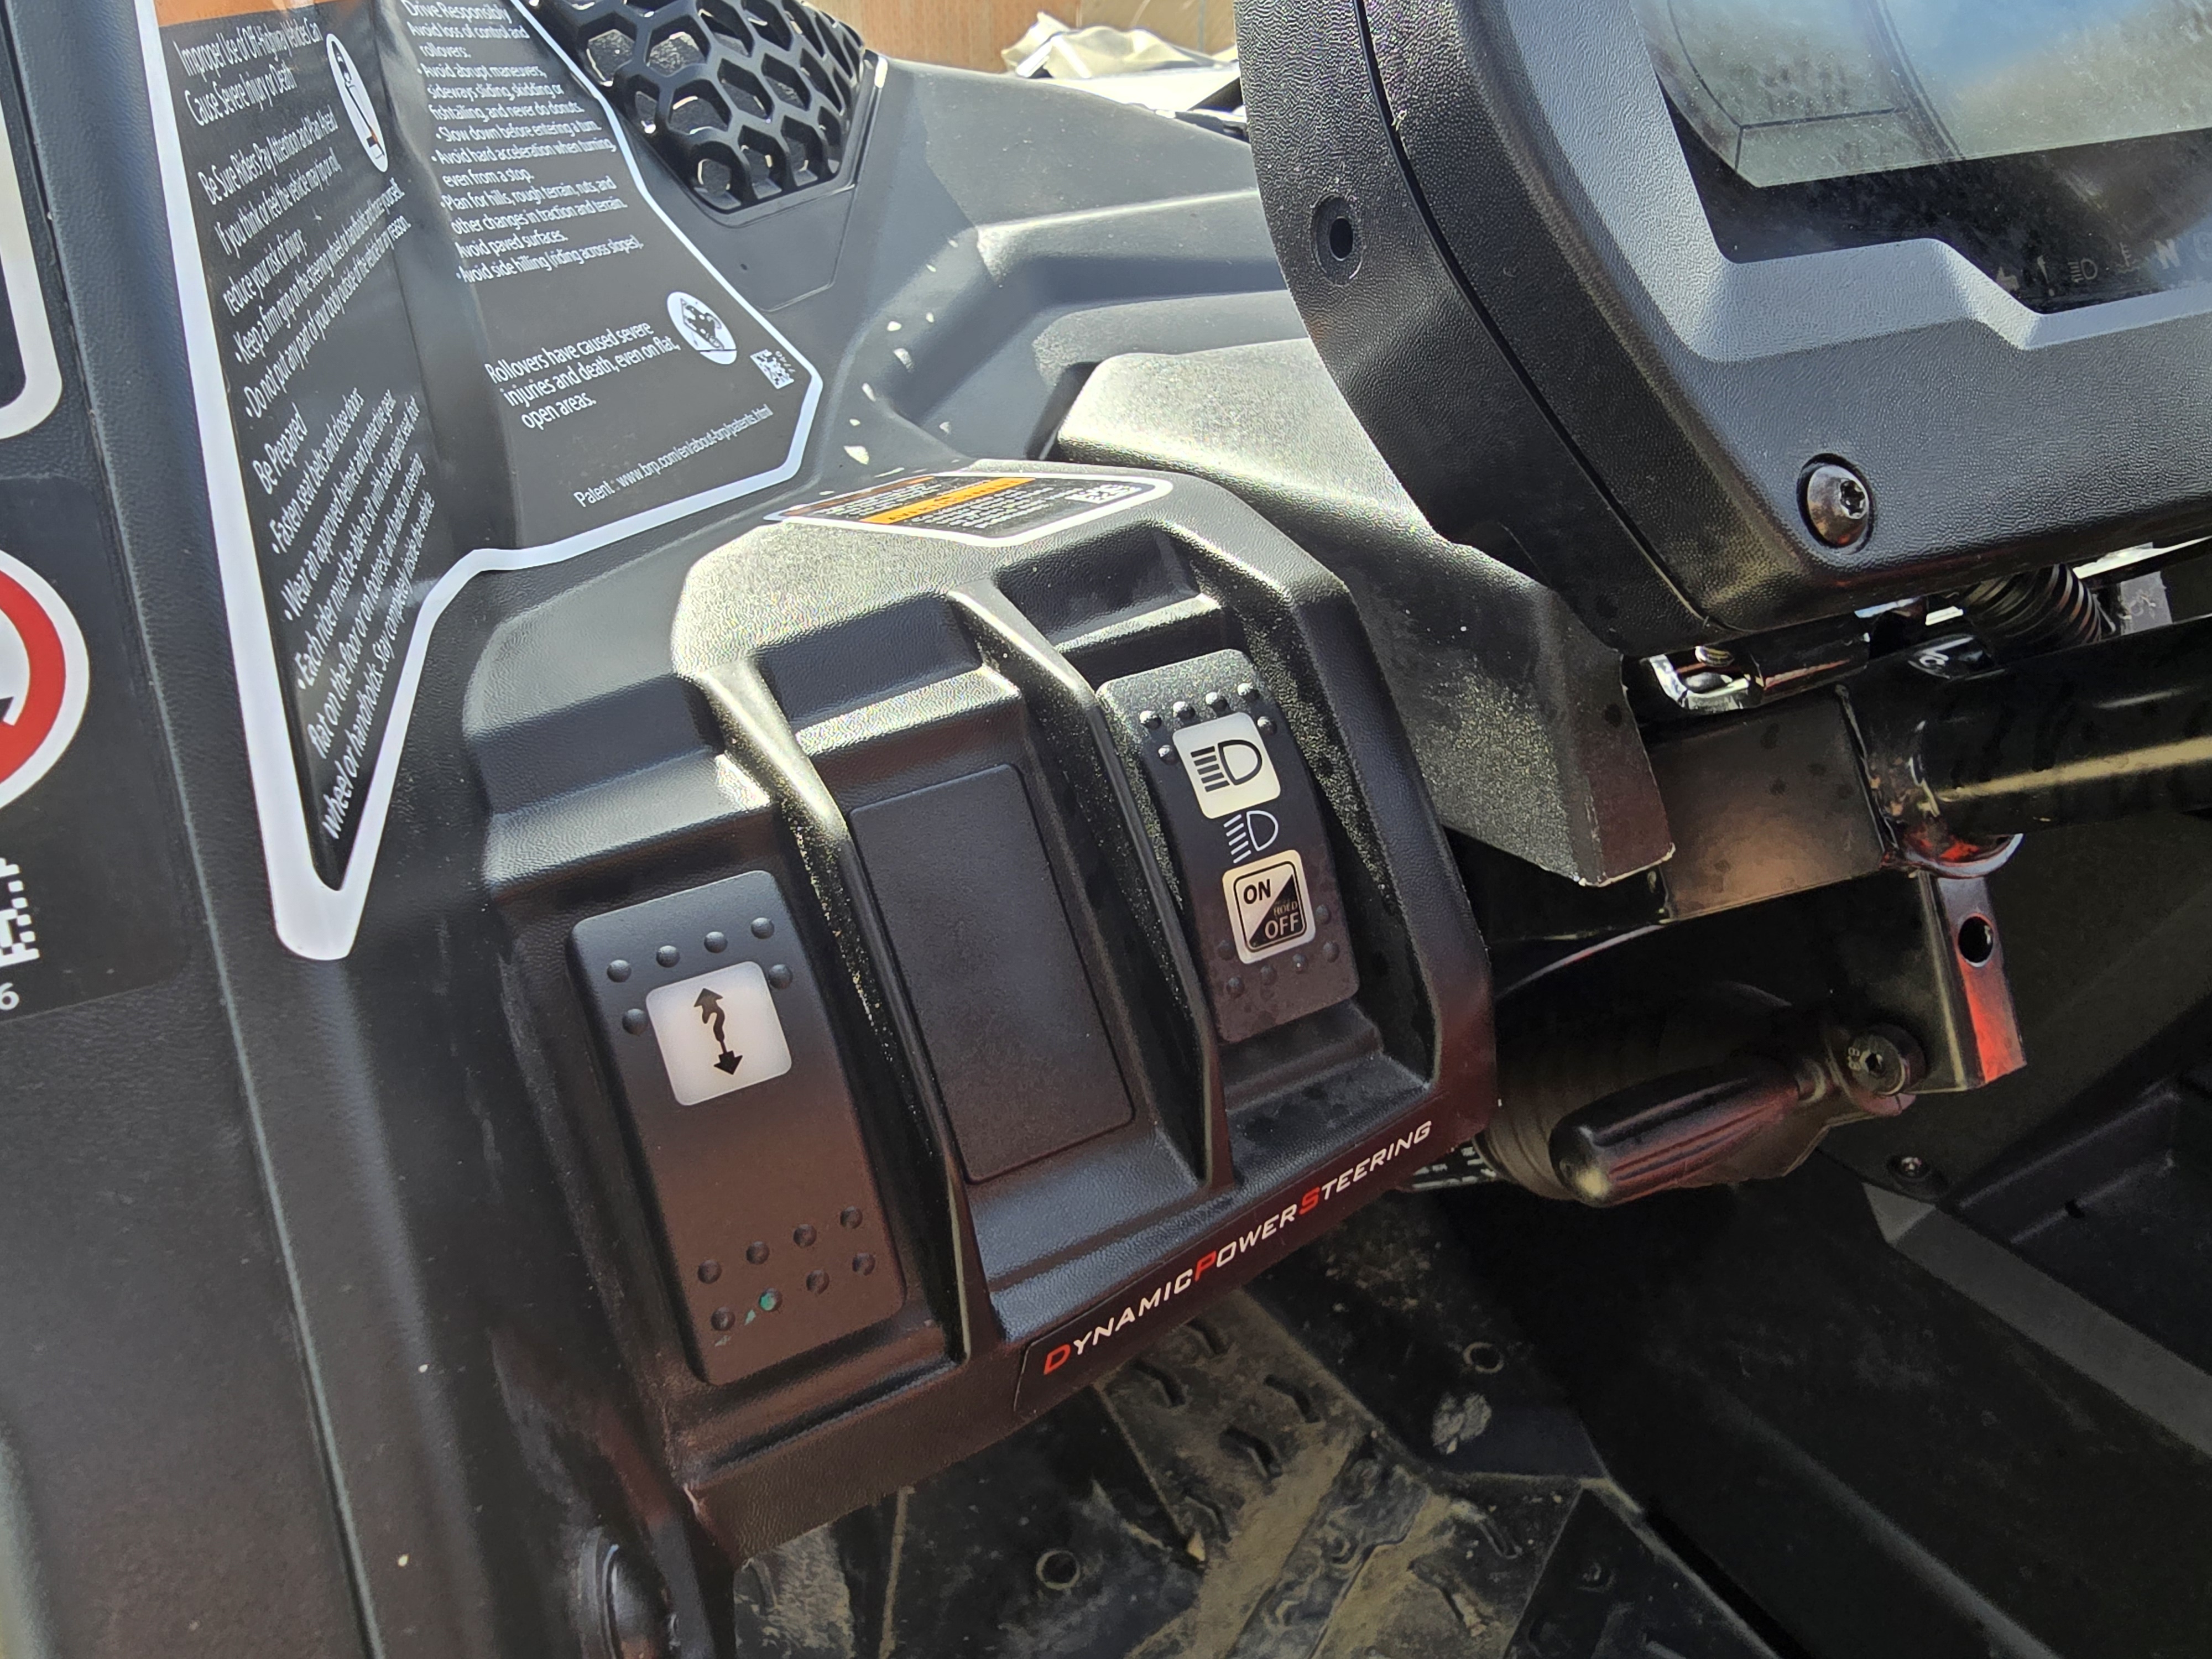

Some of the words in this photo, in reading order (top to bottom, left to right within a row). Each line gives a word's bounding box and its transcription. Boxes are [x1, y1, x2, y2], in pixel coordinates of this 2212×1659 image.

[401, 0, 442, 18] Drive
[436, 1, 512, 24] Responsibly
[406, 21, 443, 37] Avoid
[437, 22, 464, 38] loss
[462, 23, 476, 38] of
[474, 24, 511, 39] control
[509, 25, 530, 39] and
[173, 40, 227, 82] Improper
[216, 32, 242, 65] Use
[236, 27, 251, 61] of
[304, 17, 324, 43] Can
[420, 62, 456, 77] Avoid
[453, 62, 492, 81] abrupt
[184, 90, 223, 126] Cause
[212, 81, 250, 115] Severe
[239, 71, 273, 111] Injury
[269, 59, 298, 93] Death
[427, 84, 478, 102] sideways
[512, 82, 556, 98] skidding
[486, 103, 509, 118] and
[506, 106, 536, 117] never
[534, 101, 550, 115] do
[439, 126, 471, 142] Slow
[469, 125, 502, 140] down
[495, 122, 535, 138] before
[532, 121, 575, 137] entering
[197, 171, 222, 205] Be
[211, 165, 241, 197] Sure
[230, 149, 263, 186] Riders
[253, 143, 278, 176] Pay
[267, 128, 302, 165] Attention
[435, 148, 472, 164] Avoid
[466, 145, 498, 162] hard
[495, 143, 556, 160] acceleration
[553, 140, 582, 154] when
[286, 168, 311, 202] vehicle
[441, 194, 473, 211] Plan
[467, 192, 489, 207] for
[483, 189, 516, 206] hills,
[511, 185, 545, 205] rough
[596, 175, 617, 191] and
[442, 174, 474, 187] even
[468, 169, 500, 185] from
[497, 171, 508, 182] a
[505, 168, 534, 183] stop.
[258, 202, 272, 226] or
[262, 186, 283, 220] feel
[275, 182, 293, 211] the
[238, 200, 265, 238] think
[451, 217, 484, 234] other
[482, 213, 529, 230] changes
[523, 209, 541, 223] in
[535, 205, 578, 221] traction
[575, 200, 596, 215] and
[213, 221, 232, 255] If
[225, 221, 247, 259] you
[455, 238, 491, 258] Avoid
[488, 233, 525, 257] paved
[521, 229, 568, 247] surfaces.
[223, 274, 257, 316] reduce
[249, 259, 272, 300] your
[264, 242, 284, 276] risk
[276, 234, 290, 266] of
[306, 252, 334, 288] steering
[459, 263, 494, 283] Avoid
[491, 259, 518, 277] side
[510, 255, 552, 272] hilling
[544, 249, 584, 268] (riding
[578, 244, 611, 259] across
[289, 284, 304, 307] on
[295, 270, 312, 299] the
[321, 284, 345, 318] body
[259, 305, 283, 337] firm
[276, 288, 297, 328] grip
[307, 309, 320, 341] of
[313, 304, 331, 341] your
[233, 327, 267, 364] Keep
[257, 320, 270, 342] a
[296, 322, 315, 364] part
[285, 340, 304, 371] any
[484, 352, 550, 383] Rollovers
[542, 344, 580, 366] have
[577, 328, 619, 356] caused
[615, 322, 654, 343] severe
[260, 366, 280, 403] not
[273, 350, 292, 394] put
[499, 378, 555, 407] injuries
[553, 366, 582, 391] and
[578, 356, 620, 381] death,
[615, 346, 641, 368] even
[639, 341, 659, 359] on
[653, 336, 681, 353] flat,
[244, 386, 268, 418] Do
[521, 405, 557, 430] open
[556, 392, 597, 416] areas.
[264, 401, 307, 477] Prepared
[322, 422, 339, 463] and
[331, 410, 351, 444] close
[362, 406, 387, 463] protective
[305, 448, 330, 488] belts
[353, 436, 369, 474] and
[375, 453, 394, 489] back
[253, 460, 278, 494] Be
[296, 469, 317, 512] seat
[333, 458, 361, 509] helmet
[573, 481, 615, 507] Patent
[270, 498, 305, 553] Fasten
[312, 488, 345, 564] approved
[358, 513, 372, 536] to
[363, 496, 378, 524] sit
[348, 523, 367, 561] able
[383, 519, 397, 557] and
[304, 550, 322, 581] an
[338, 549, 357, 578] be
[280, 566, 313, 617] Wear
[330, 562, 352, 612] must
[314, 598, 338, 646] rider
[355, 610, 368, 637] or
[360, 593, 374, 622] on
[294, 630, 325, 686] Each
[338, 626, 363, 674] floor
[330, 663, 352, 701] the
[322, 760, 354, 839] wheel
[343, 744, 359, 778] or
[373, 630, 395, 671] Stay
[384, 566, 413, 640] completely
[324, 692, 342, 726] on
[307, 712, 334, 759] flat
[1243, 879, 1271, 904] ON
[1273, 900, 1298, 916] HOLD
[1265, 912, 1298, 939] OFF
